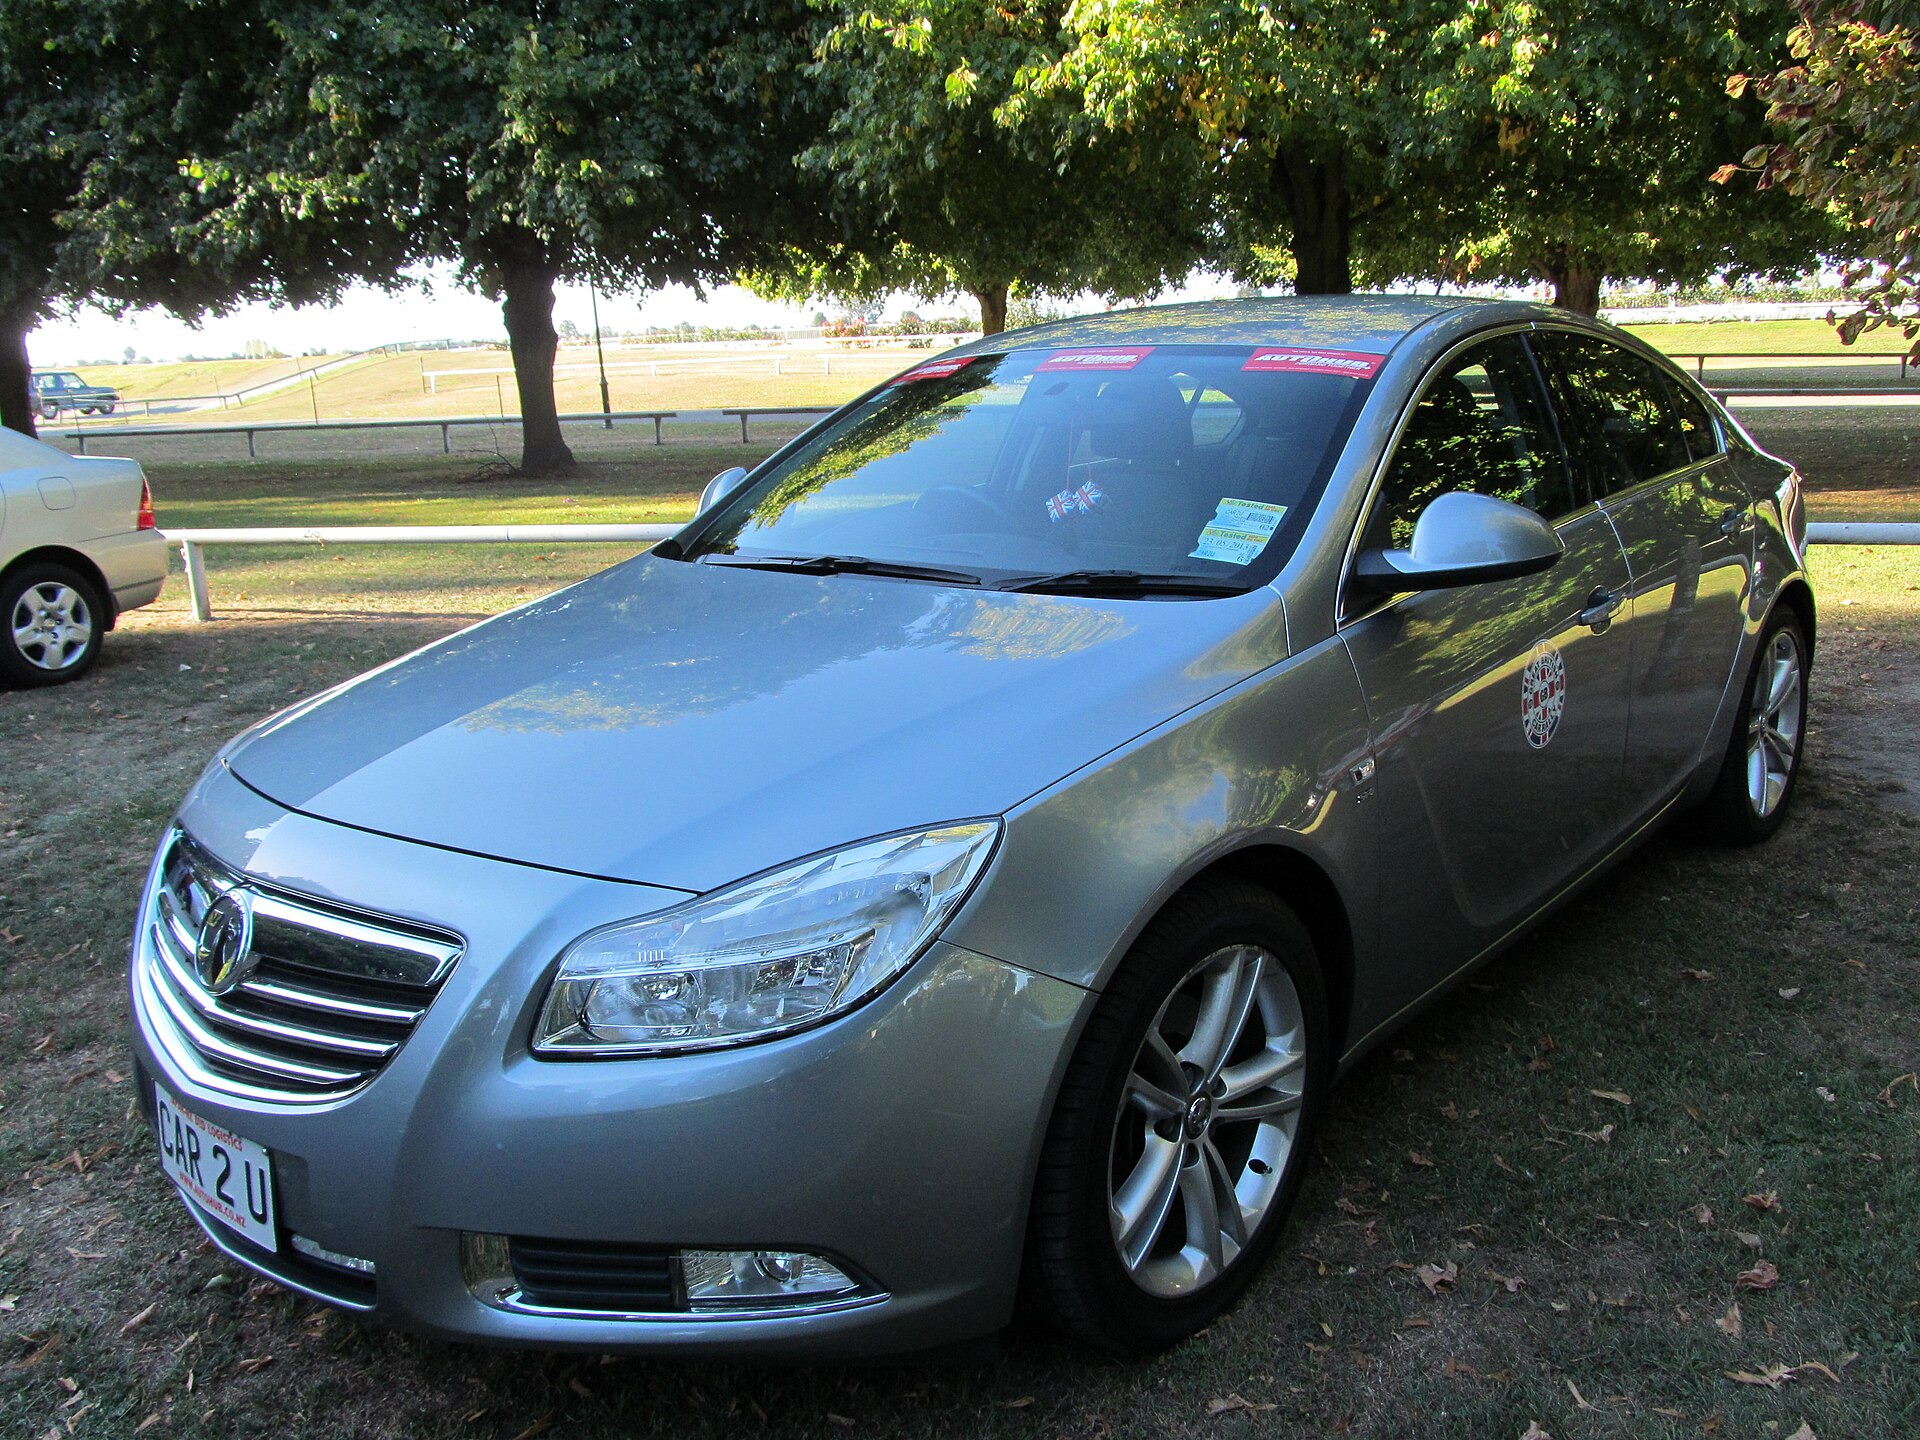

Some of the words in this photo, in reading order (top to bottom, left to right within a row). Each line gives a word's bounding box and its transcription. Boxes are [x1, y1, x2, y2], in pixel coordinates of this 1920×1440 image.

[1237, 501, 1264, 510] Tested
[1219, 531, 1248, 541] Tested
[1540, 686, 1549, 703] GB
[159, 1100, 204, 1187] CAR
[212, 1144, 234, 1207] 2
[244, 1159, 268, 1225] U
